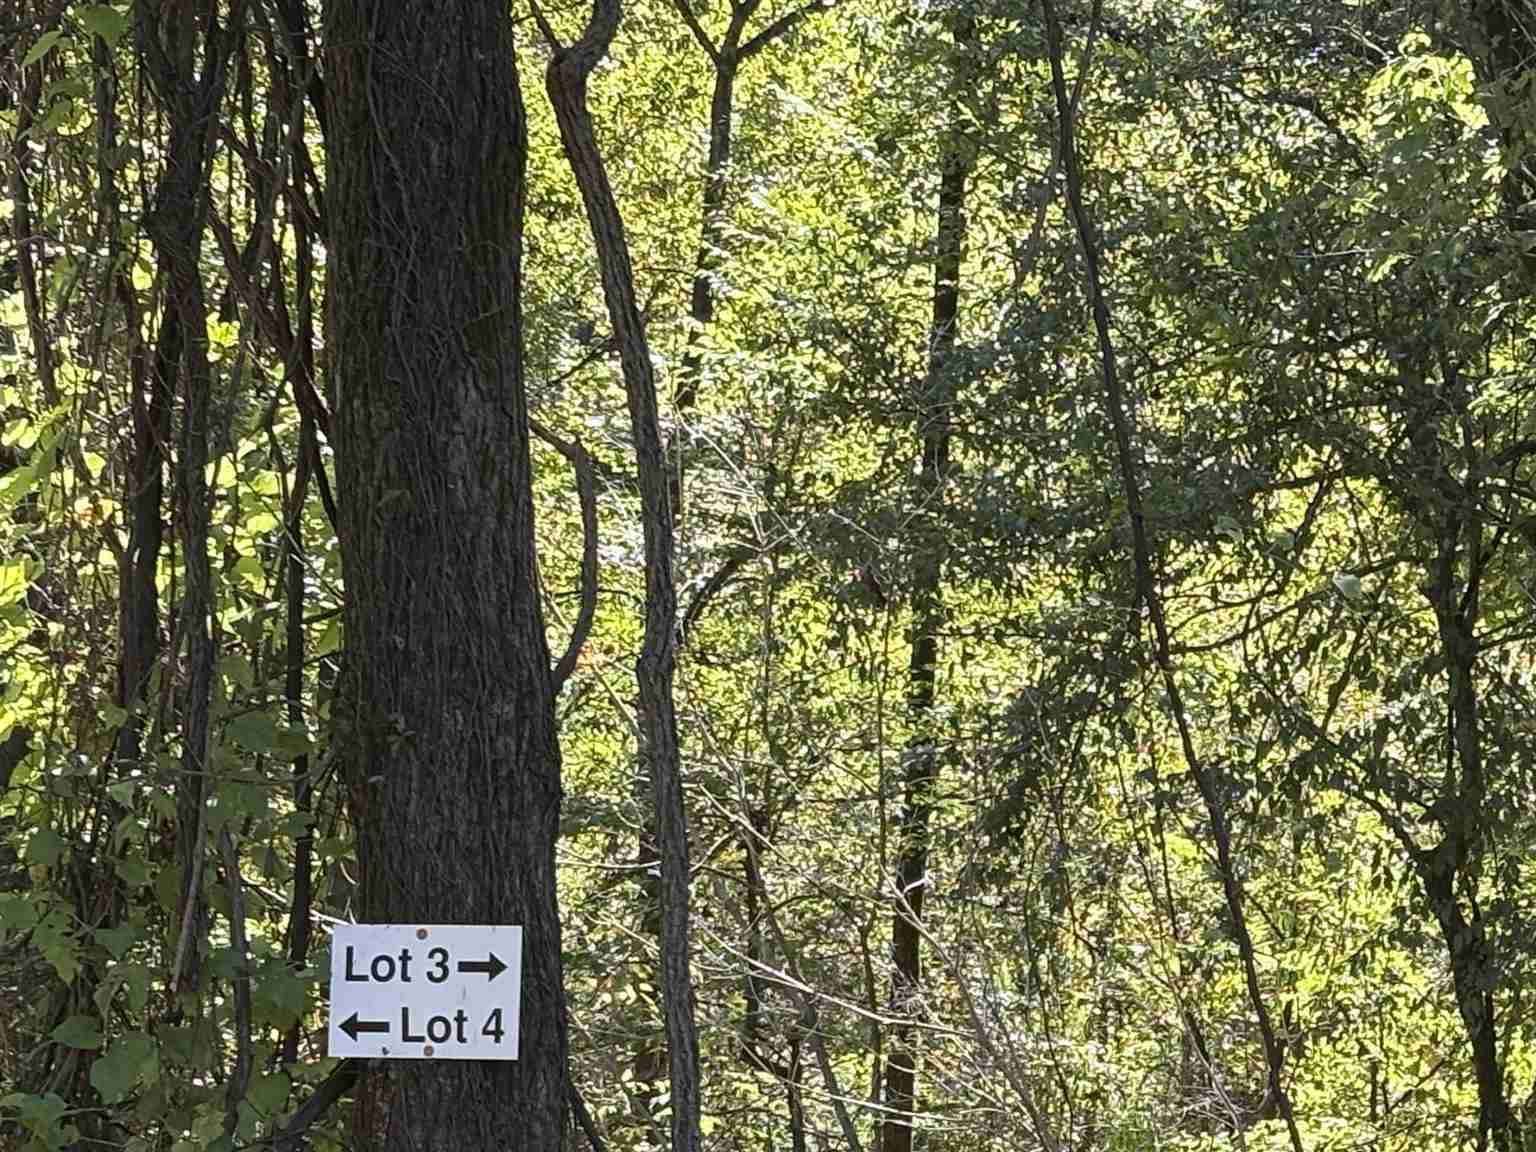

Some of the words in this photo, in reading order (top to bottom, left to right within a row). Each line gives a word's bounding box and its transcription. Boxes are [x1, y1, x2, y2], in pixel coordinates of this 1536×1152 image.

[344, 945, 413, 983] Lot
[426, 947, 450, 984] 3
[401, 1006, 468, 1044] Lot
[481, 1008, 505, 1044] 4
